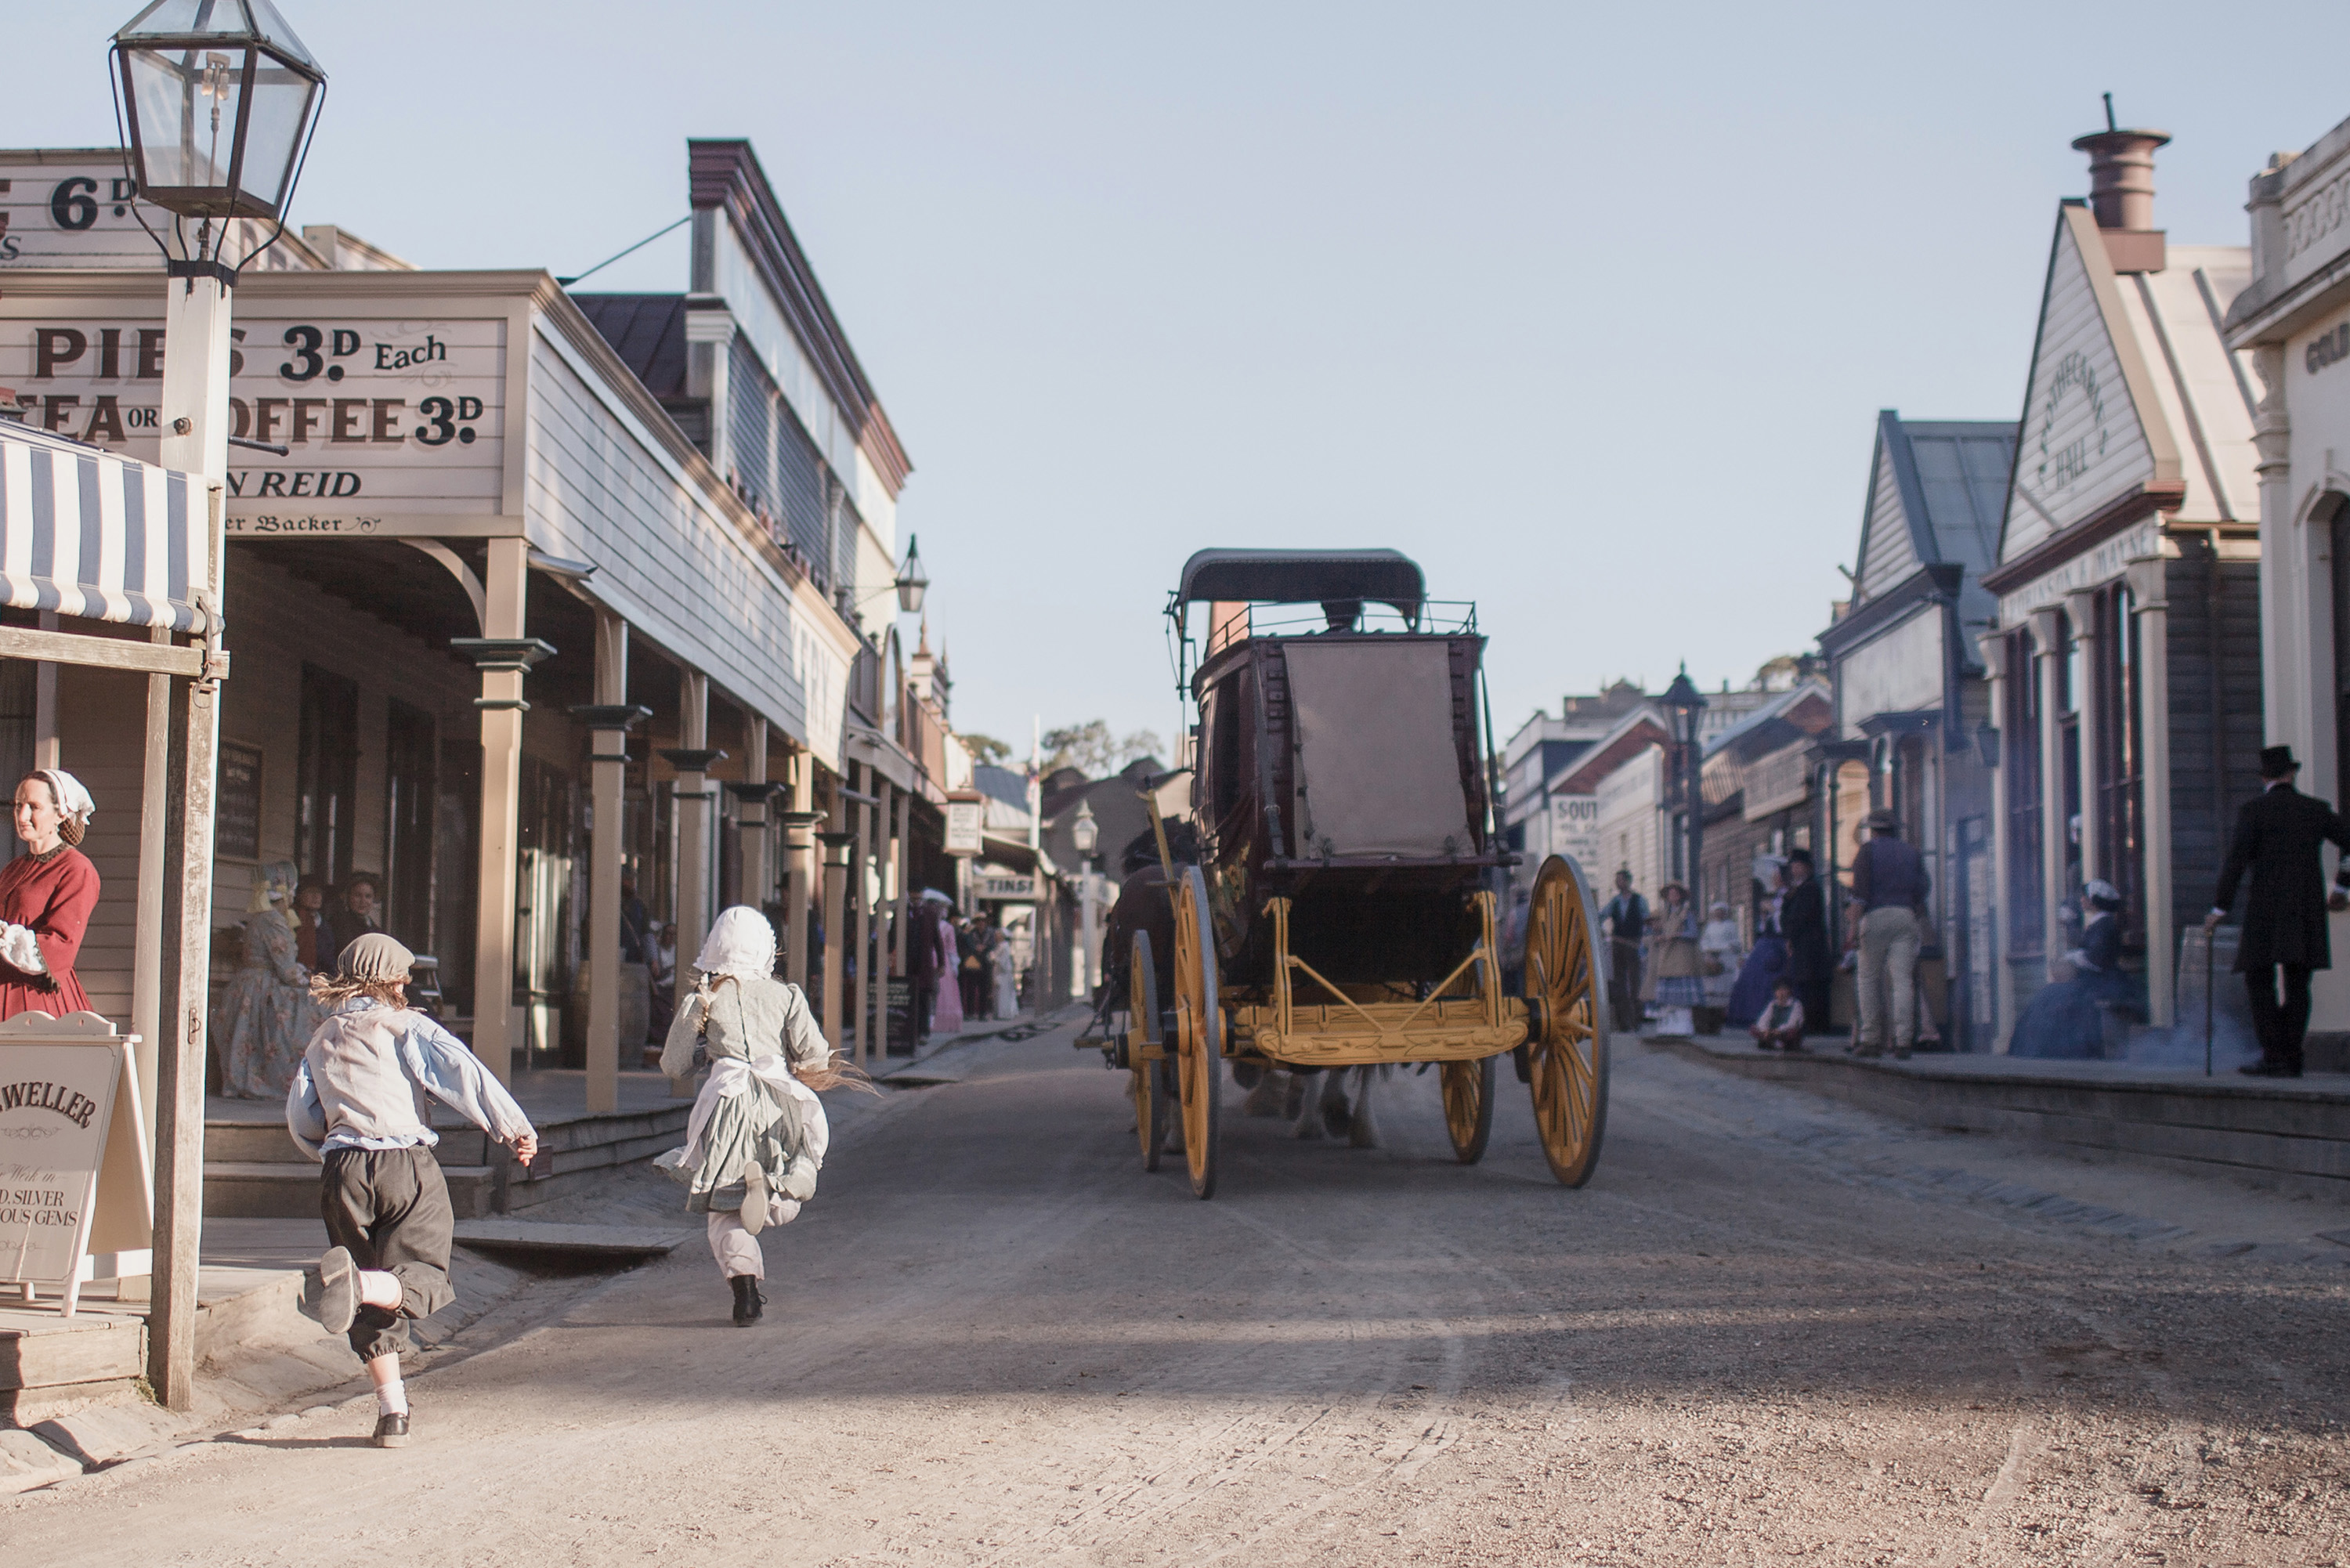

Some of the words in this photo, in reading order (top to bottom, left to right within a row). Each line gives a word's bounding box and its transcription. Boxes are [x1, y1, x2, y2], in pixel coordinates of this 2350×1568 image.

[374, 334, 447, 370] Each
[128, 407, 161, 428] OR
[258, 471, 362, 497] REID
[255, 515, 342, 532] Backer
[13, 1190, 64, 1207] SILVER
[34, 1209, 78, 1227] GEMS
